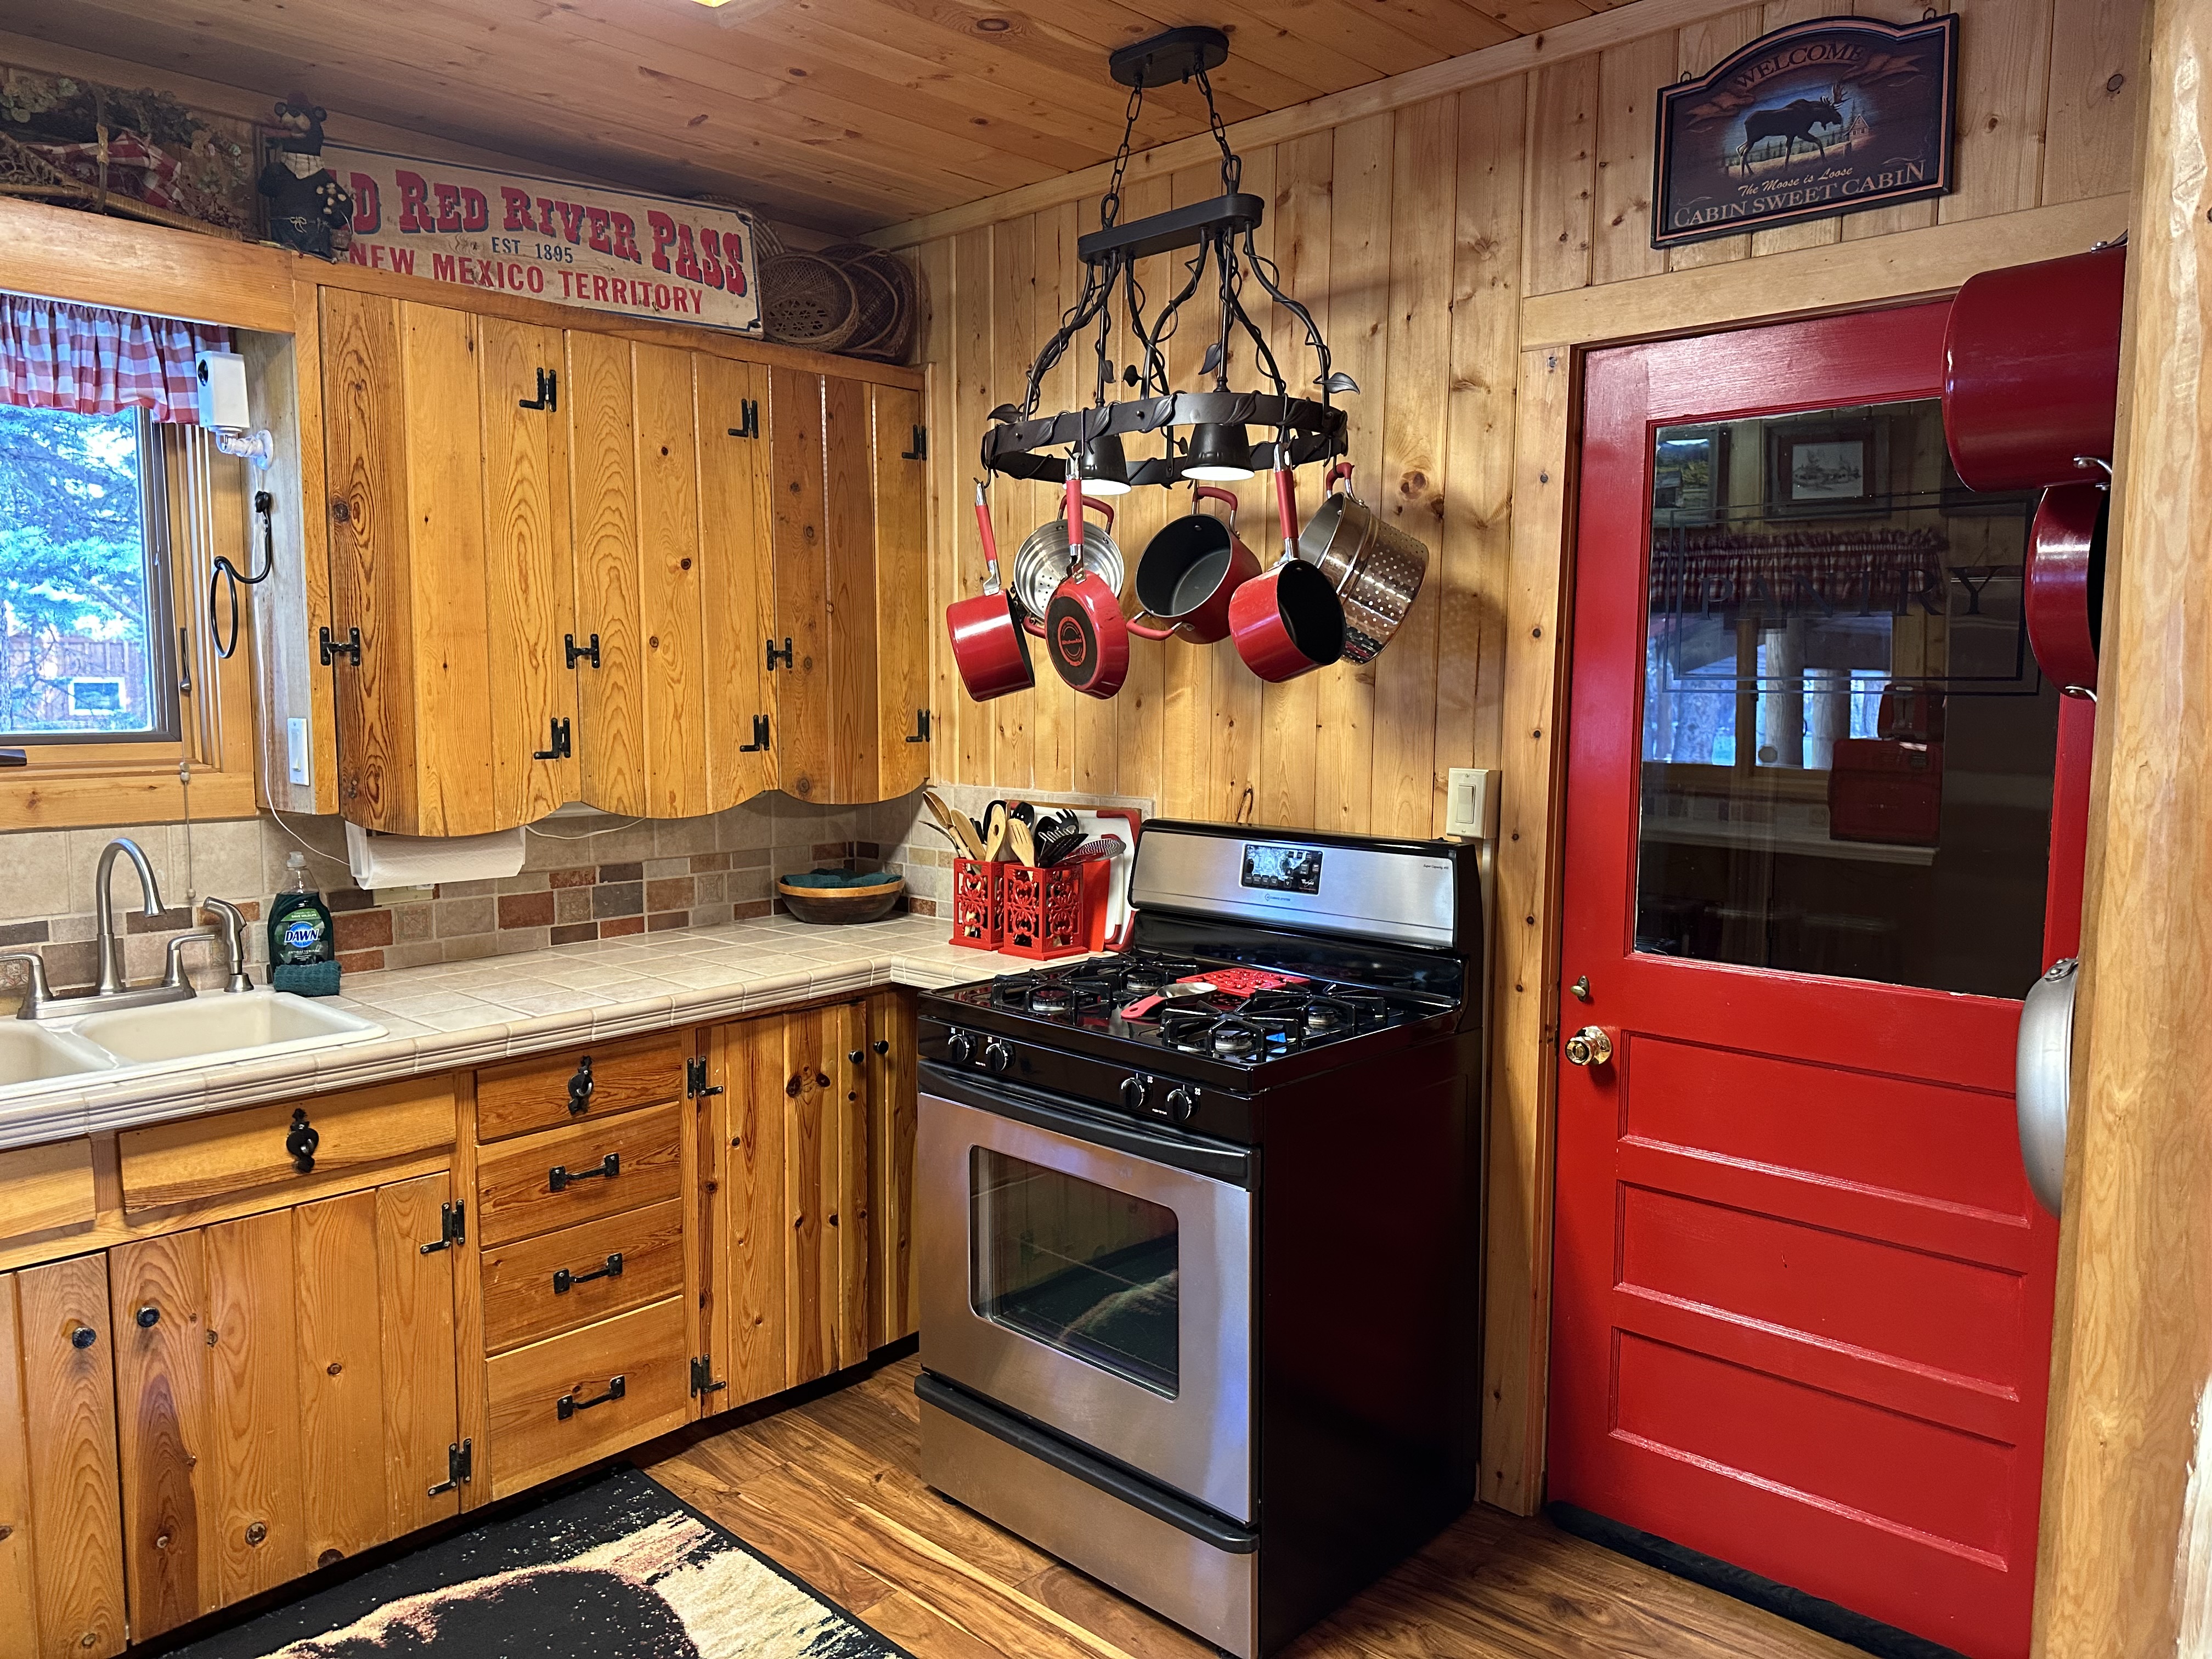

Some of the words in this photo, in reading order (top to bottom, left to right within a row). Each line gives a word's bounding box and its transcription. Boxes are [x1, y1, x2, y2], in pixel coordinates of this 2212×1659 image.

[1735, 42, 1864, 88] WELCOME
[1674, 201, 1748, 228] CABIN
[1753, 183, 1837, 213] SWEET
[1842, 160, 1926, 195] CABIN
[1738, 183, 1759, 197] The
[1762, 178, 1799, 192] Moose
[1803, 174, 1814, 184] is
[1818, 167, 1853, 182] Loose
[396, 170, 489, 234] RED
[500, 186, 642, 264] RIVER
[647, 210, 748, 298] PASS
[492, 236, 521, 255] EST
[535, 243, 573, 264] 1895
[349, 242, 415, 275] NEW
[432, 253, 544, 294] MEXICO
[557, 270, 703, 315] TERRITORY
[1698, 566, 2005, 620] PANTRY
[285, 929, 319, 943] DAWN
